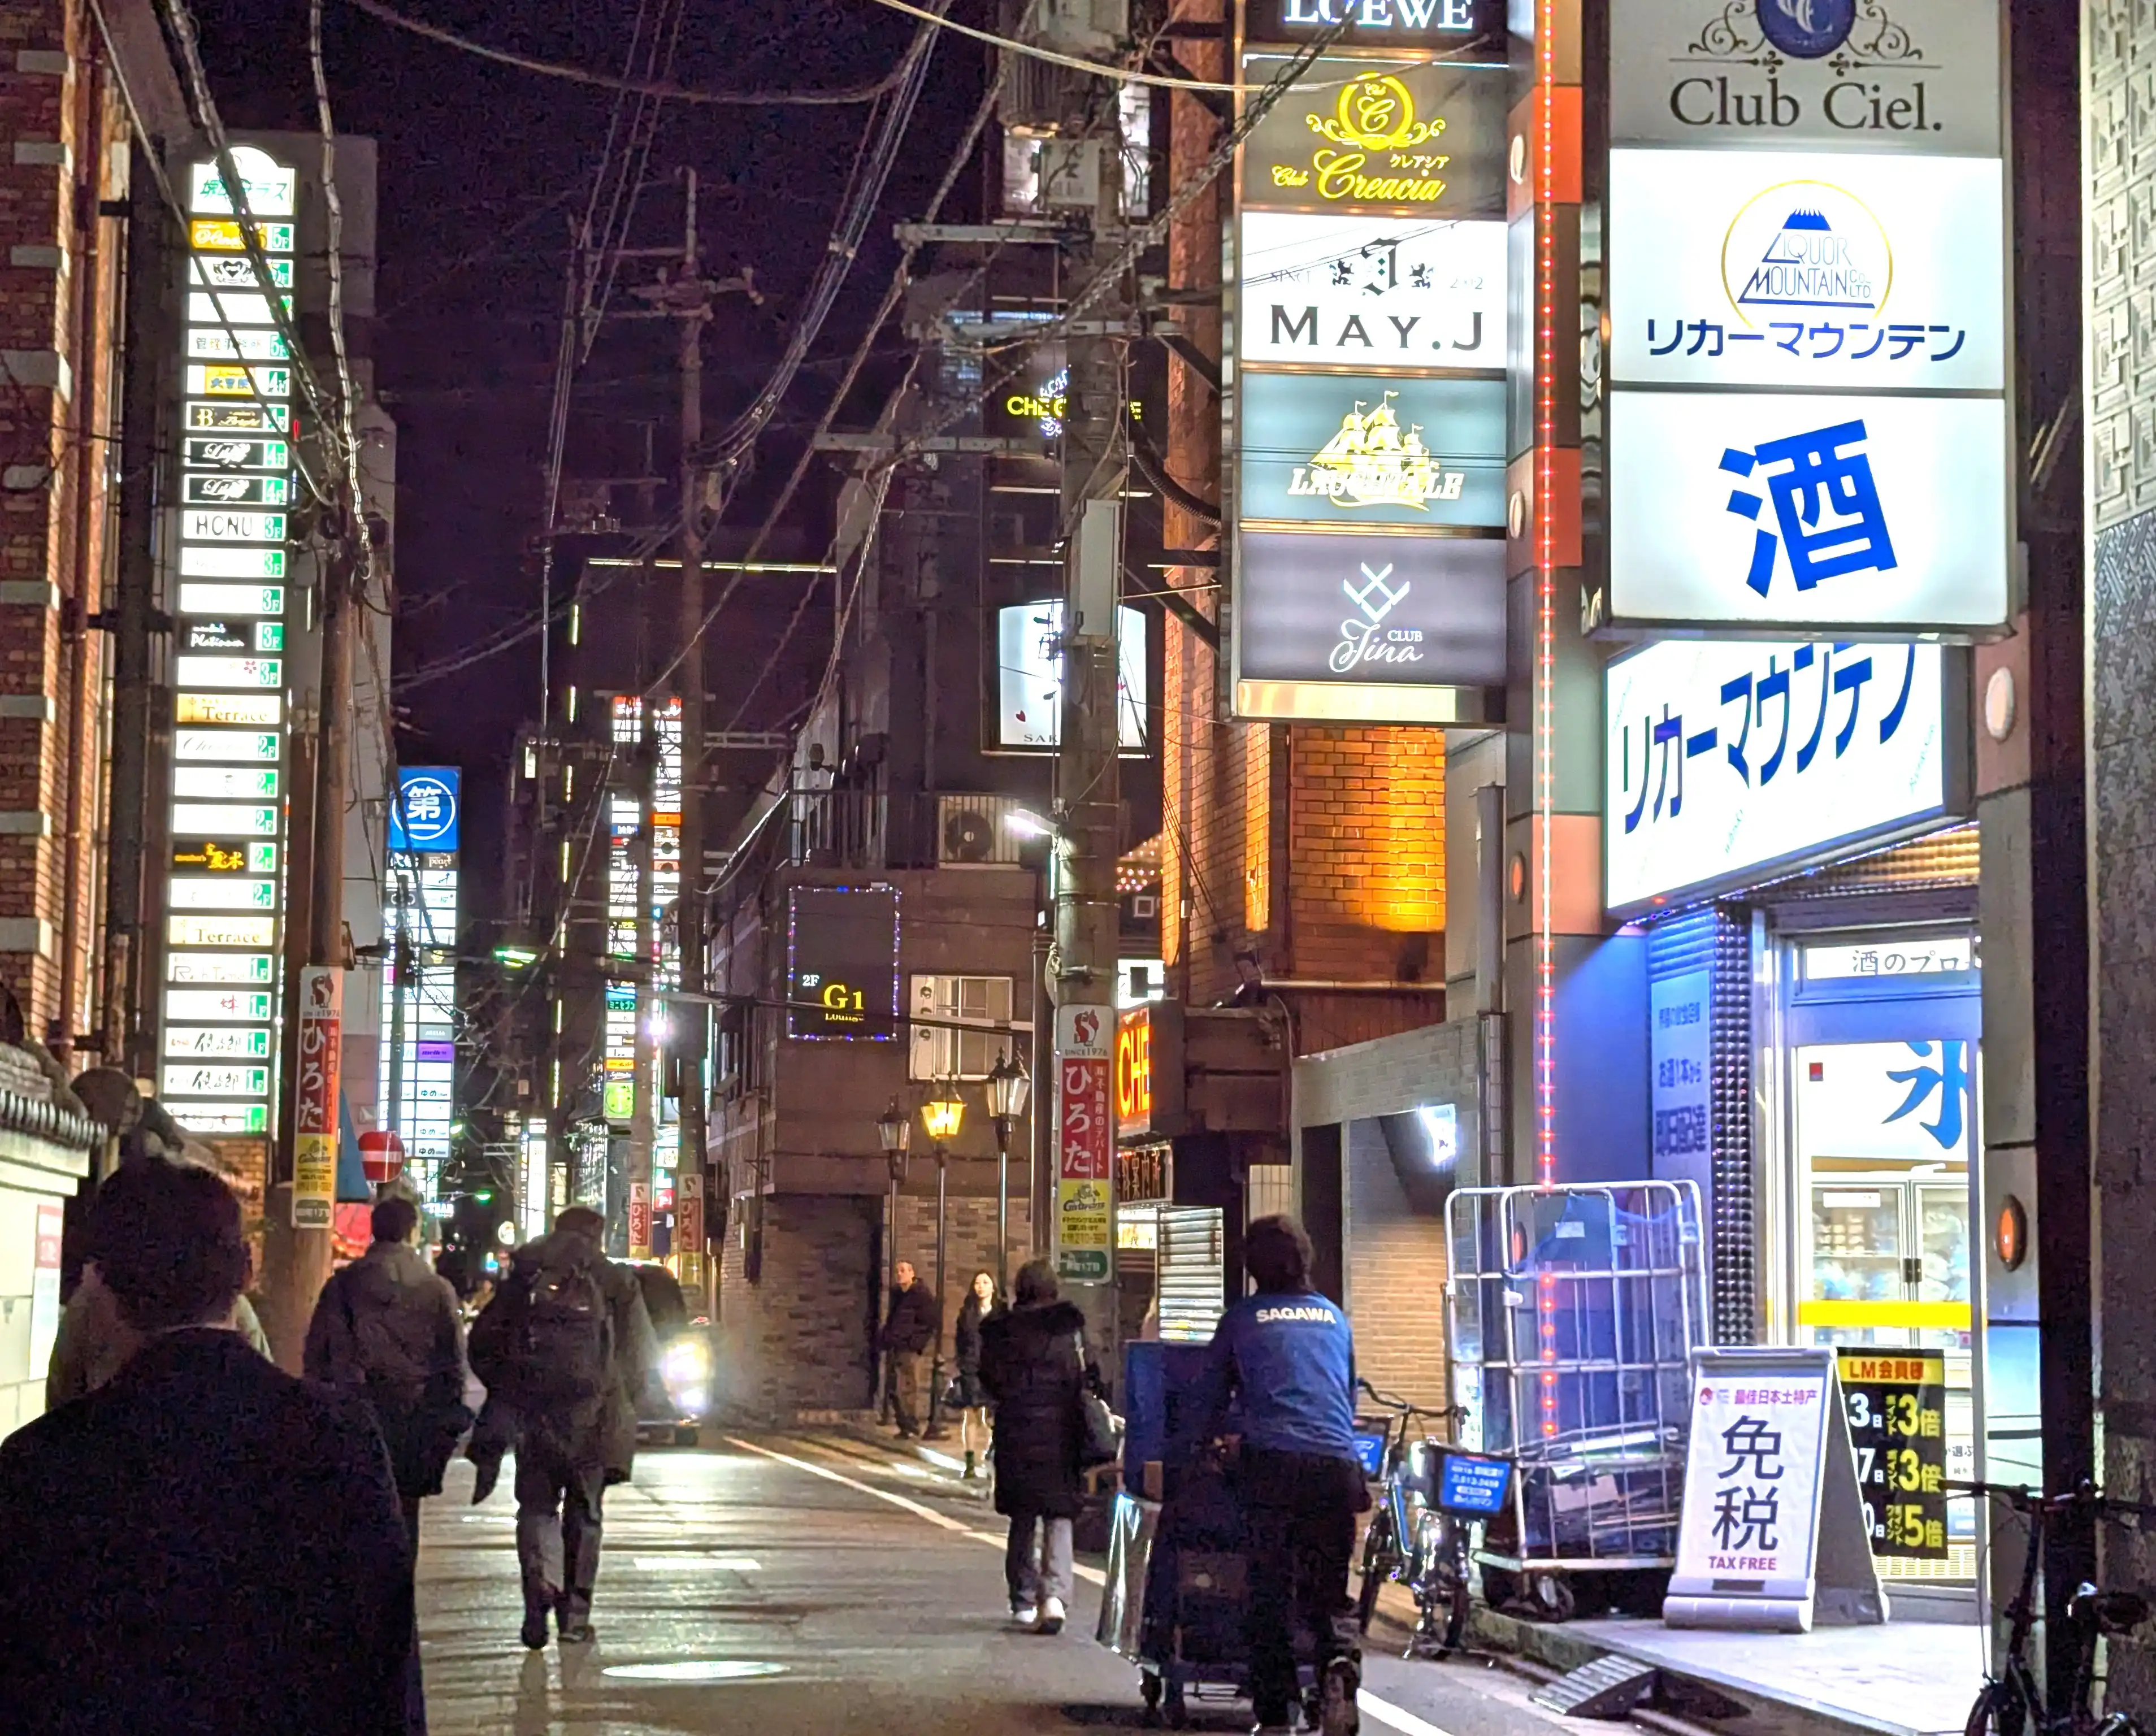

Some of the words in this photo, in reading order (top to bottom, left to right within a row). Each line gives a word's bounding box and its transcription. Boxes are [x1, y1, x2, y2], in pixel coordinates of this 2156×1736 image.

[1670, 77, 1800, 128] Club
[1823, 81, 1942, 132] Ciel.
[1272, 165, 1309, 187] Club
[1313, 149, 1447, 202] Creacia
[1762, 232, 1853, 266] LIQUOR
[1737, 266, 1847, 303] MOUNTAIN
[1270, 304, 1483, 351] MAY.J
[1647, 318, 1966, 362] リカーマウンテン
[1718, 419, 1898, 599] 酒
[264, 517, 283, 539] 3F
[263, 589, 280, 611] 3F
[1387, 630, 1423, 642] CLUB
[260, 662, 278, 685] 3F
[202, 706, 268, 721] Terrace
[258, 736, 276, 758] 2F
[407, 785, 442, 830] 第一
[195, 928, 260, 943] Terrace
[802, 974, 820, 987] 2F
[249, 995, 268, 1018] 1F
[823, 984, 865, 1010] G1
[248, 1032, 266, 1054] 1F
[246, 1069, 264, 1092] 1F
[300, 1026, 326, 1129] ひろた
[1065, 1065, 1092, 1173] ひろた
[1256, 1307, 1337, 1323] SAGAWA
[1711, 1415, 1785, 1551] 免税
[1708, 1556, 1736, 1570] TAX
[1738, 1555, 1776, 1571] FREE
